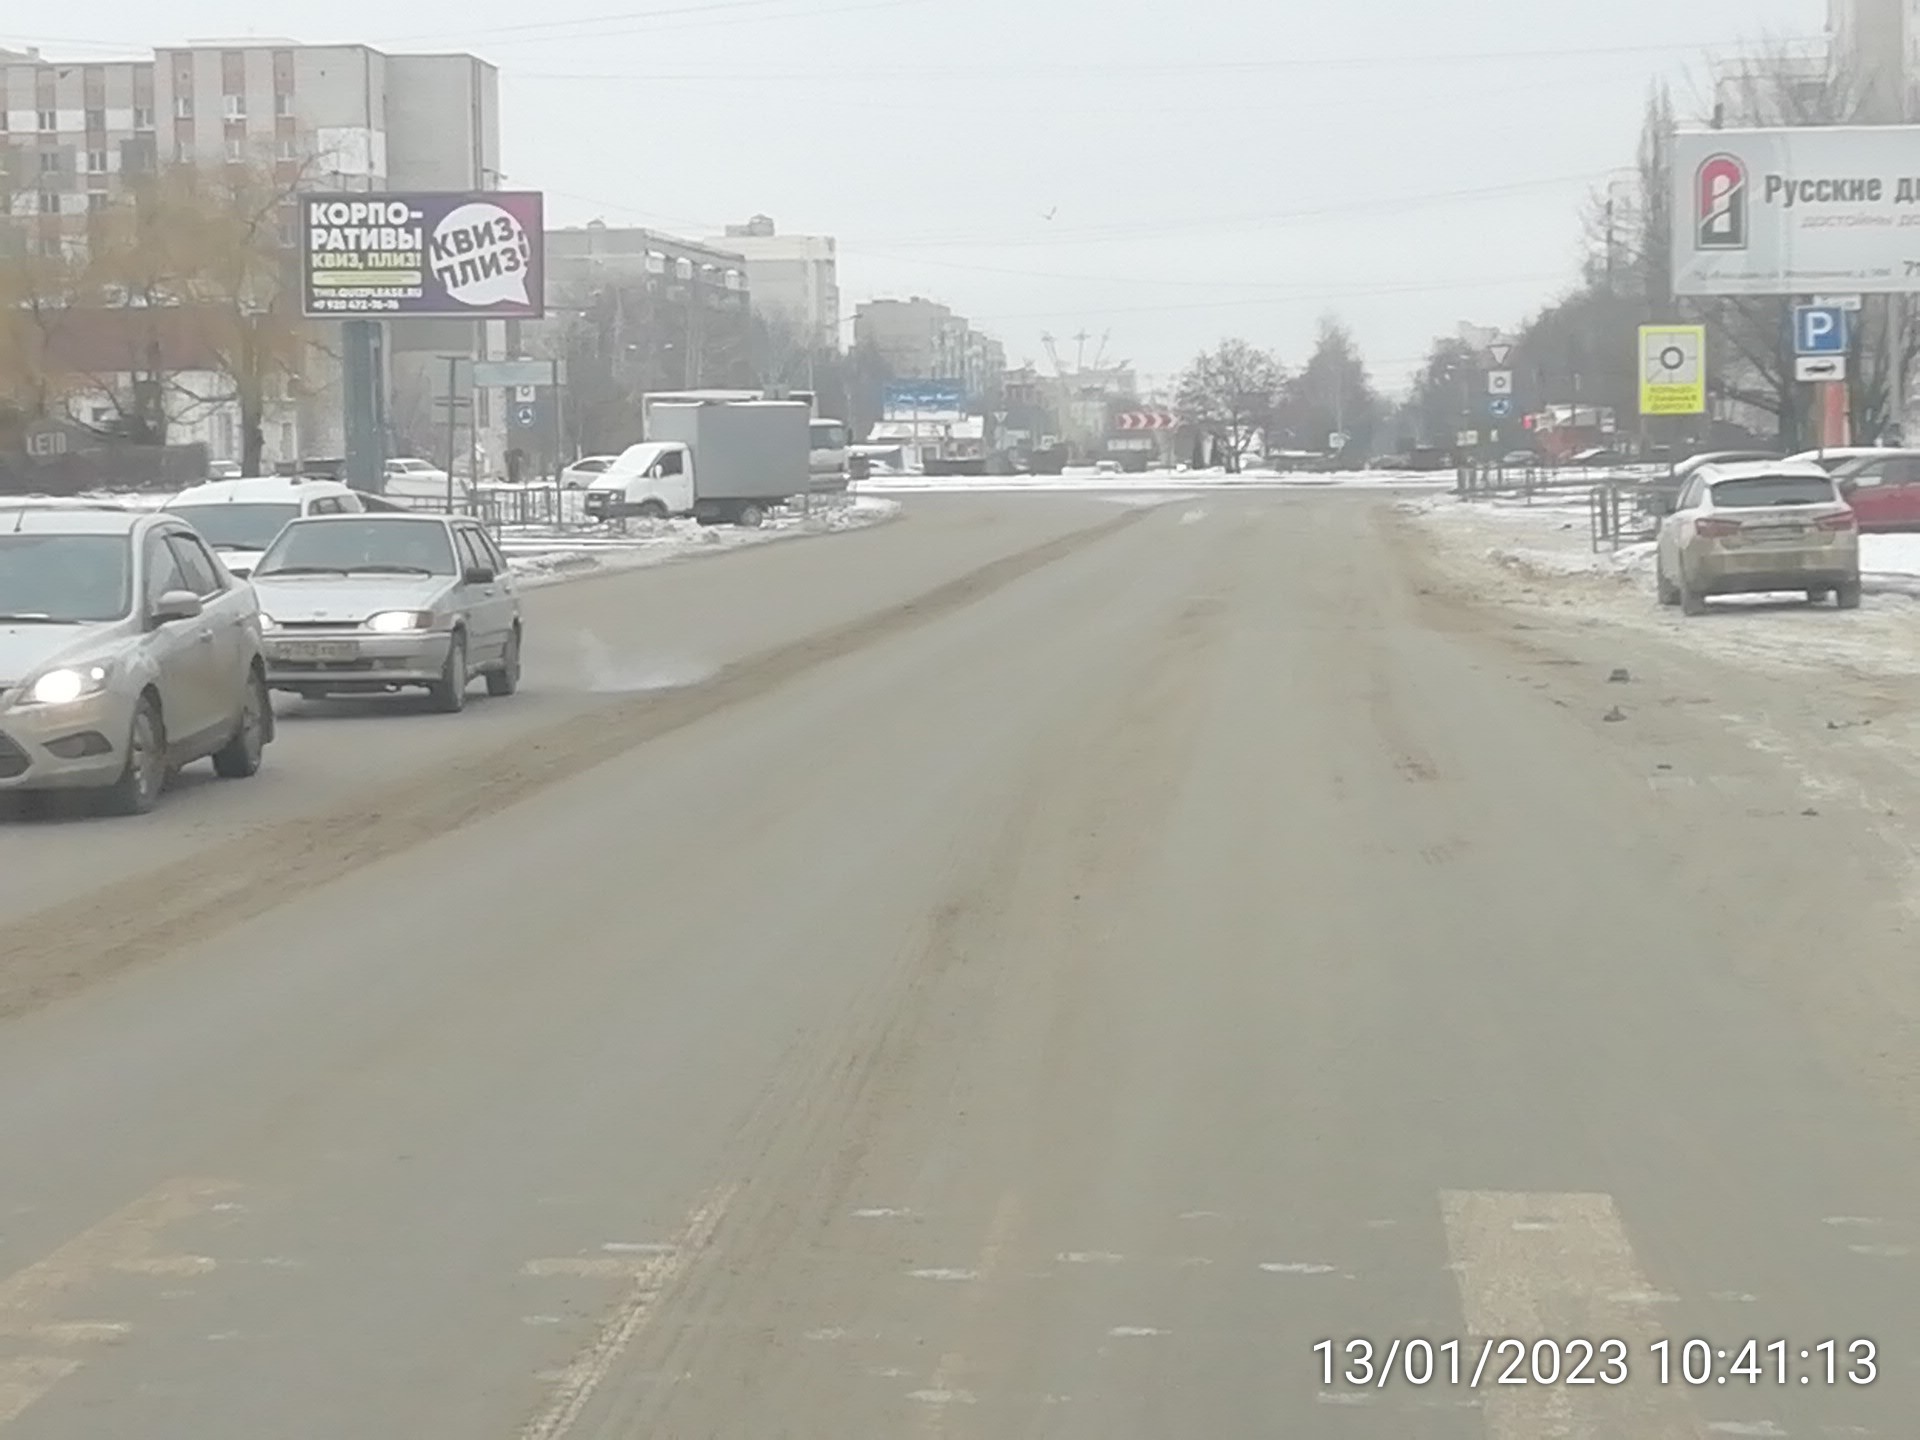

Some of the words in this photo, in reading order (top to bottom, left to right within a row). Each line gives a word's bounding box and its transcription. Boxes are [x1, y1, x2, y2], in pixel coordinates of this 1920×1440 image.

[1765, 174, 1882, 208] Русские
[310, 202, 423, 225] КОРПО-
[310, 228, 422, 250] РАТИВЫ
[312, 253, 364, 269] КВИЗ,
[367, 253, 421, 268] ПЛИЗ!
[1806, 312, 1833, 347] P
